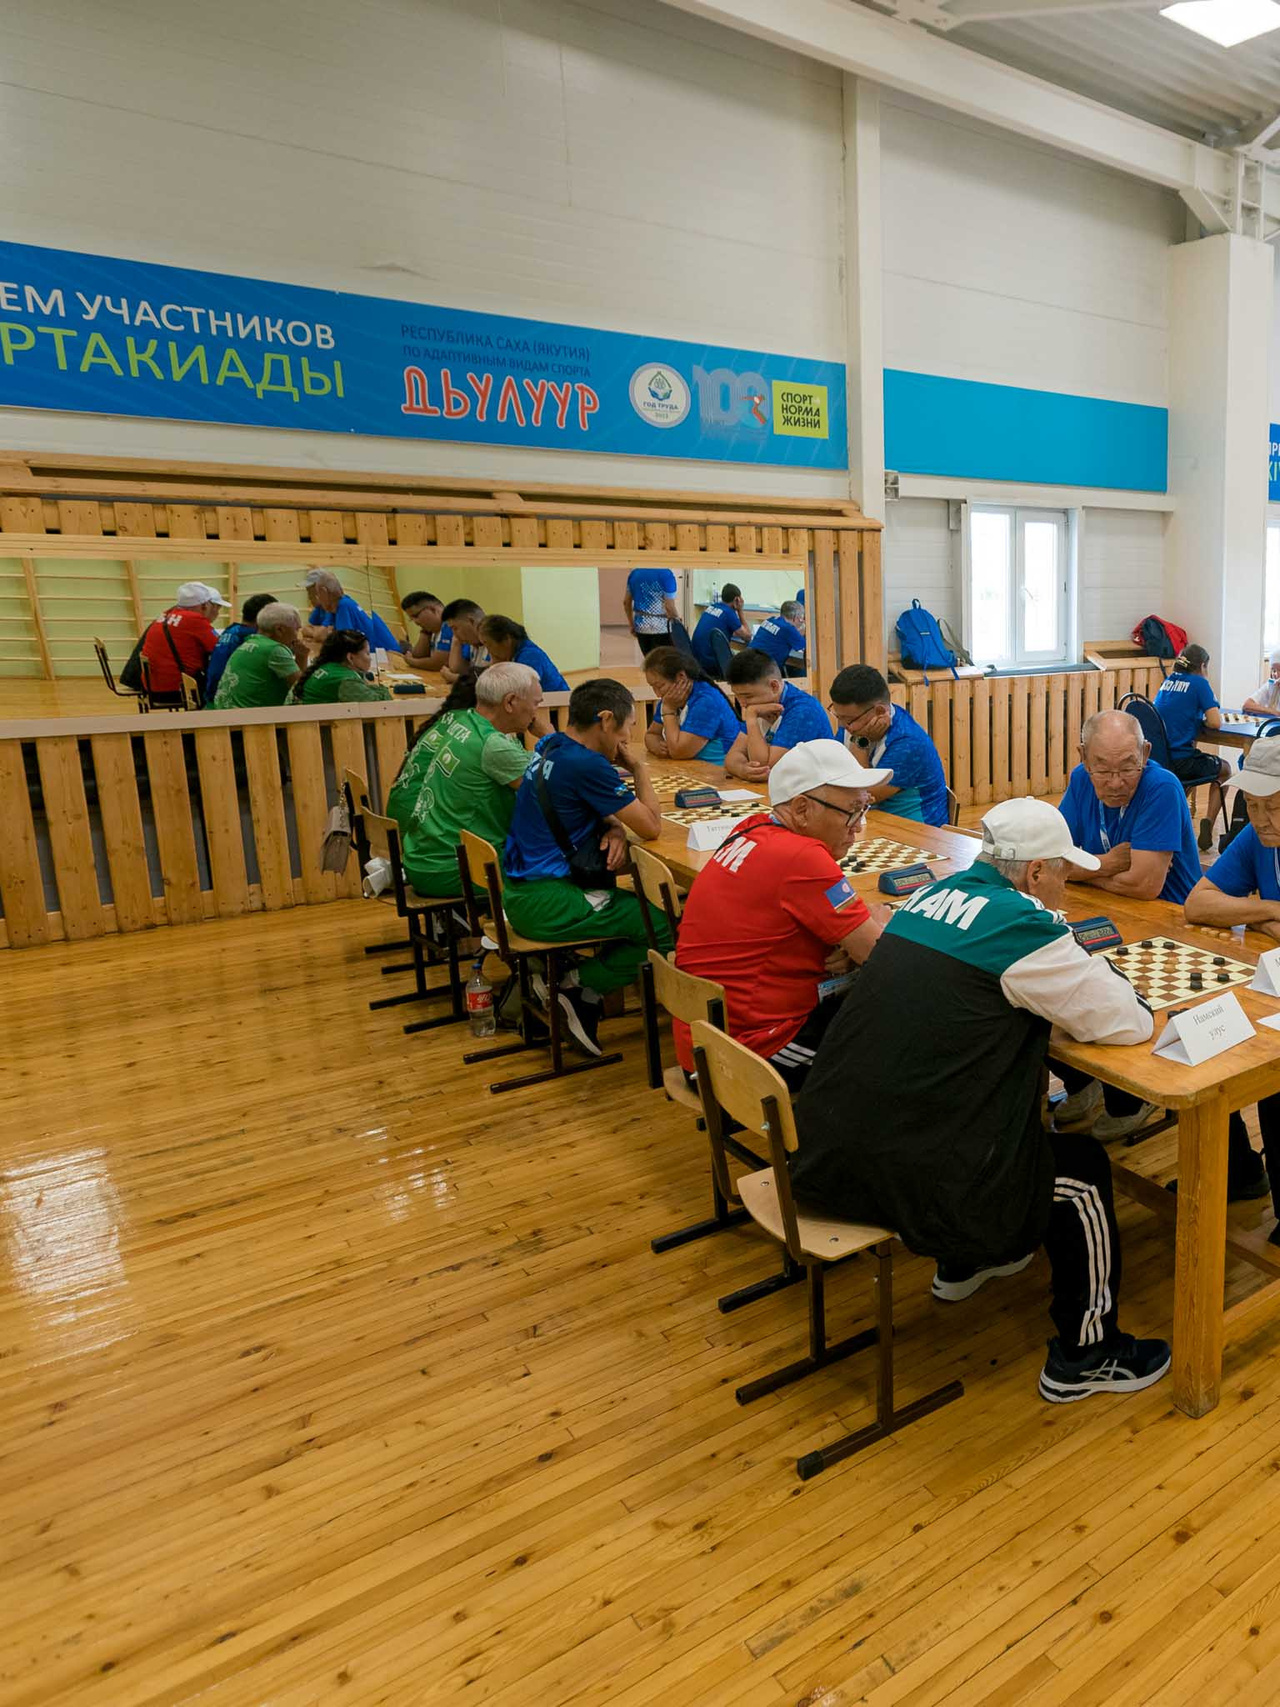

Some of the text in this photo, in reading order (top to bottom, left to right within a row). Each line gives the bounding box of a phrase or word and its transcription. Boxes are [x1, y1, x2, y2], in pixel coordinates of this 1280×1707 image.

[76, 291, 335, 350] УЧАСТНИКОВ
[401, 324, 590, 362] РЕСПУБЛИКА САХА (ЯКУТИЯ)
[403, 345, 591, 378] ПО АДАПТИВНЫМ ВИДАМ СПОРТА
[781, 391, 813, 404] СПОРТ
[782, 405, 821, 418] НОРМА
[782, 415, 821, 429] ЖИЗНИ
[1193, 1004, 1225, 1026] Намский
[1209, 1024, 1227, 1041] улус
